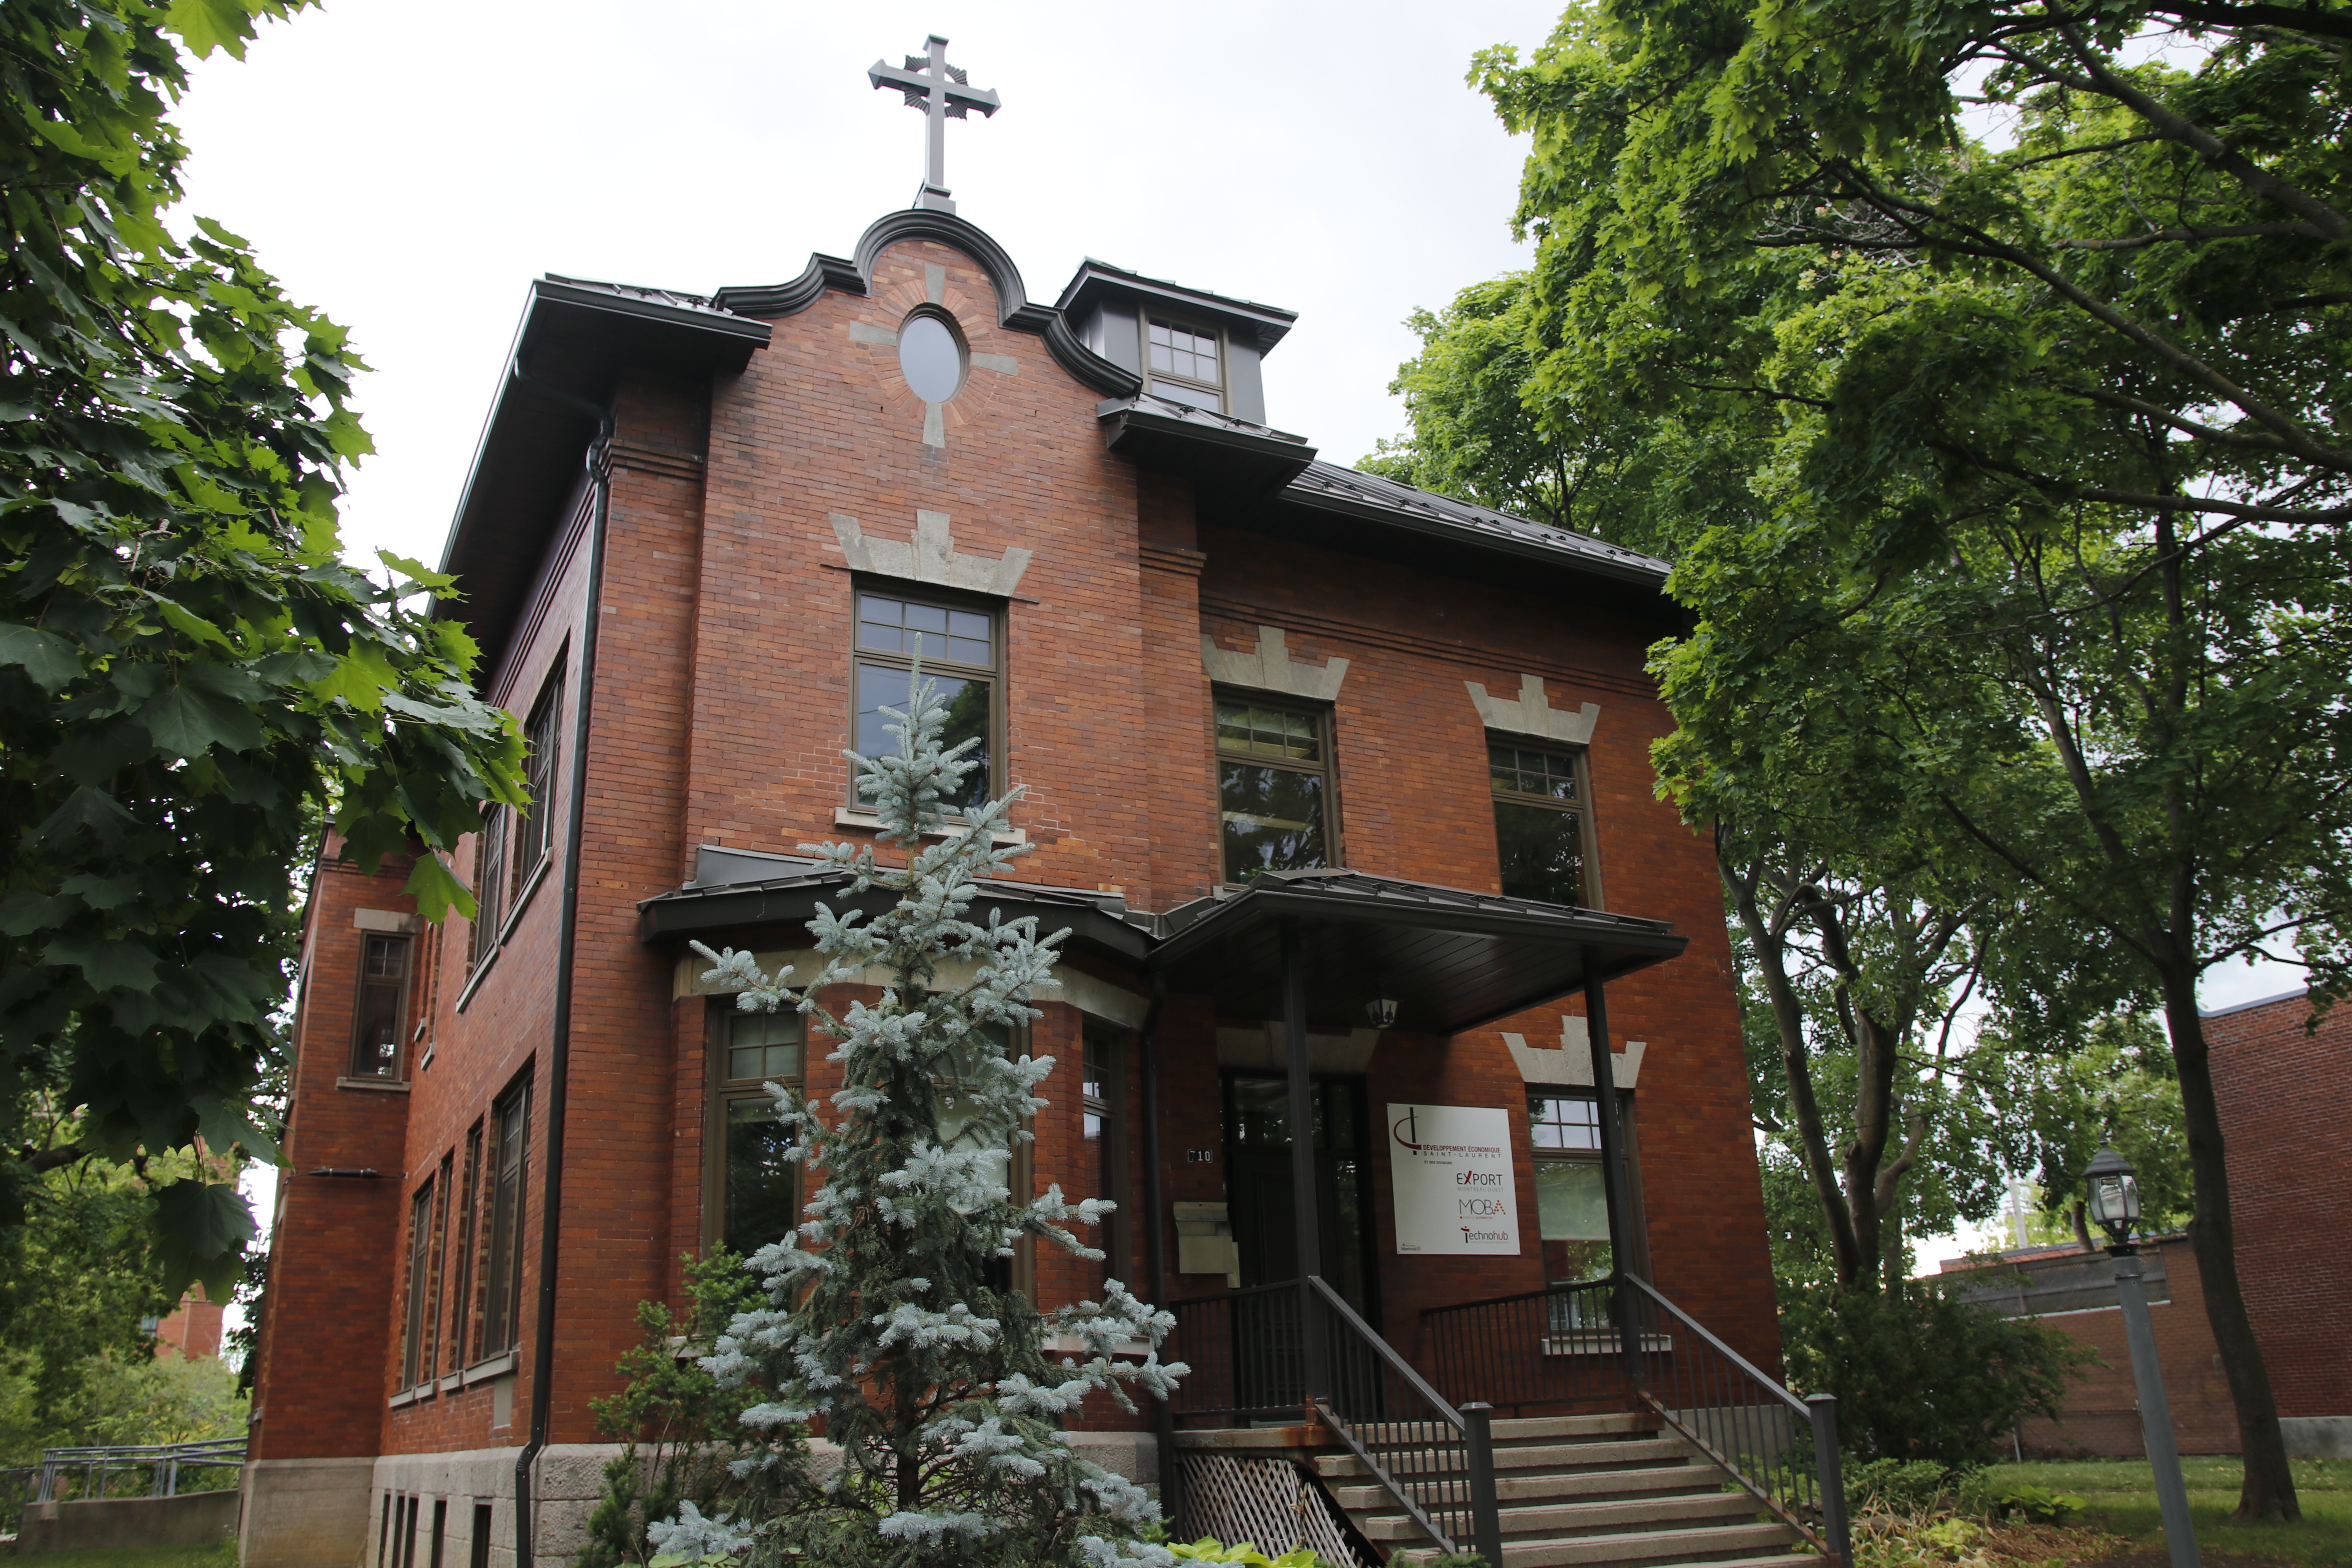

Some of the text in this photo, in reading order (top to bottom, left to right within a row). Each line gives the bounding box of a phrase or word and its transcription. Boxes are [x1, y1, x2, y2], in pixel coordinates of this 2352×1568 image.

[1423, 1143, 1501, 1153] DÉVELOPPEMENT ÉCONOMIQUE
[1190, 1151, 1210, 1161] 710
[1457, 1171, 1503, 1185] EXPORT
[1459, 1199, 1506, 1215] MOBA
[1461, 1226, 1508, 1243] Technohub
